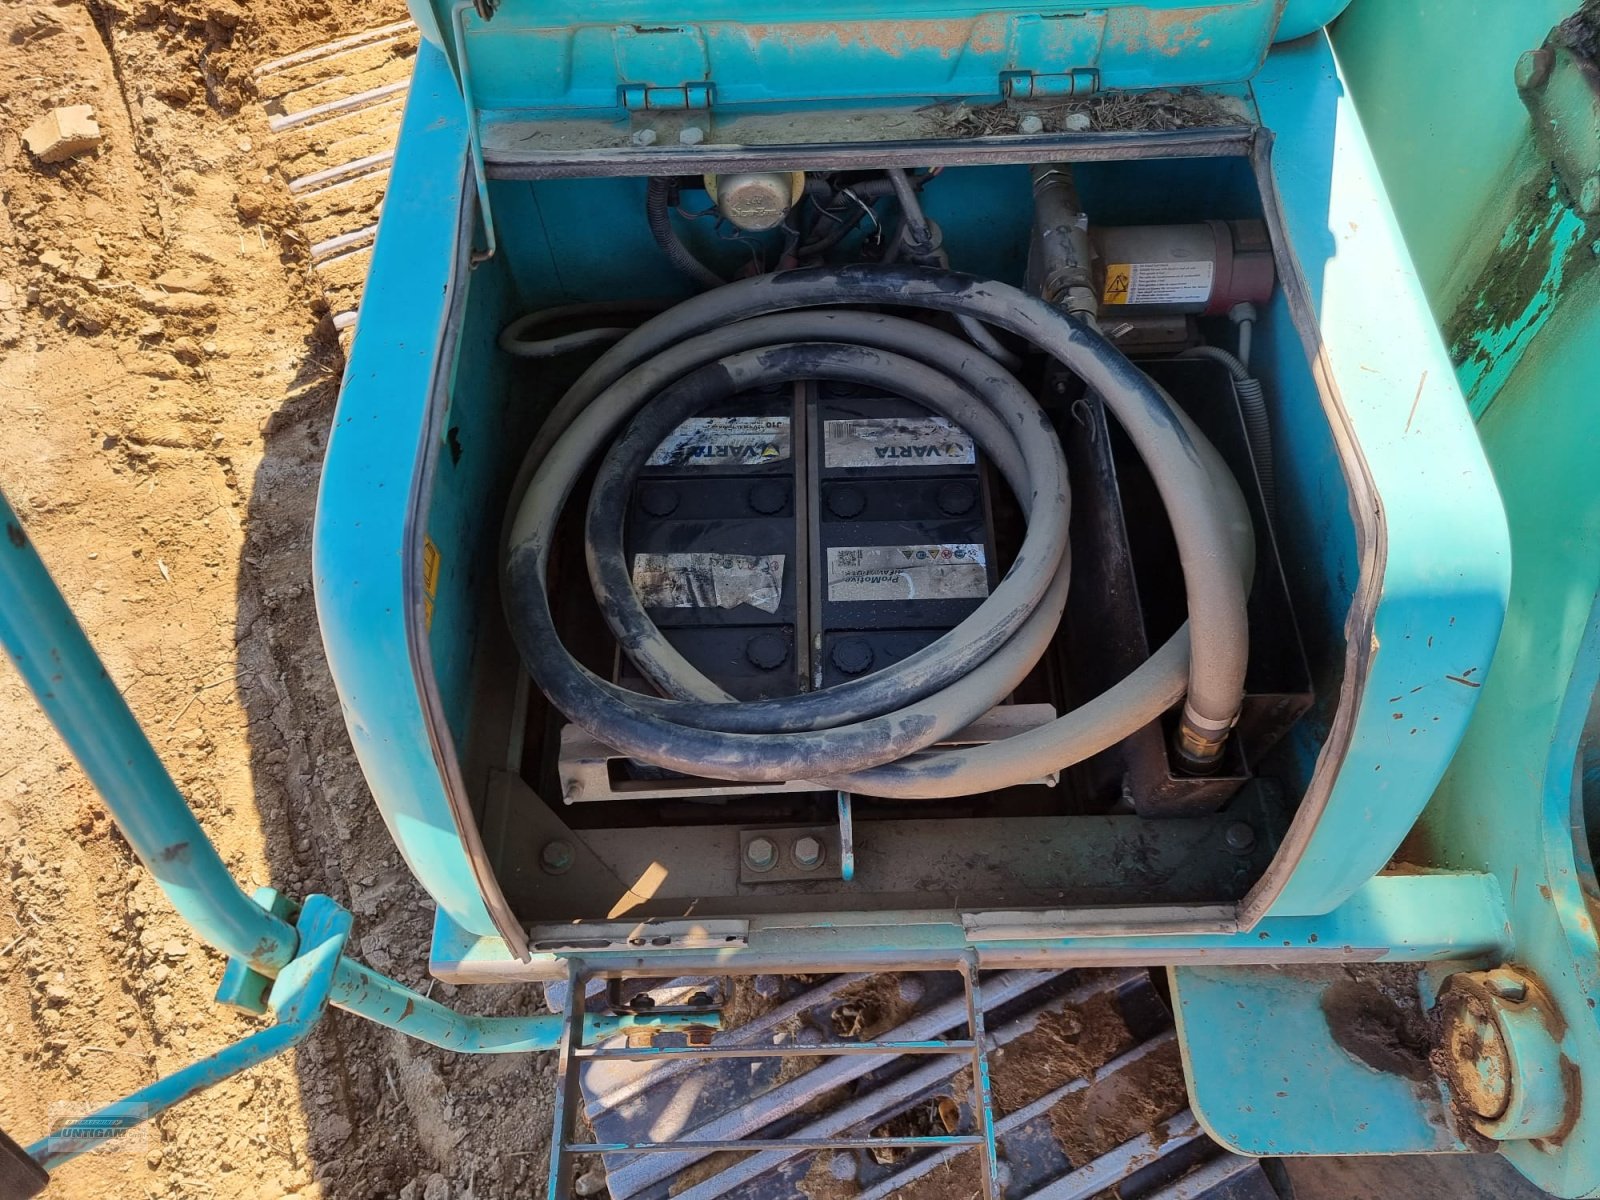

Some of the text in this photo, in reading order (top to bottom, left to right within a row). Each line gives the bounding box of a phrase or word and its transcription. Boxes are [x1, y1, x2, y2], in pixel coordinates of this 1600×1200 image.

[766, 421, 782, 429] J10
[691, 445, 759, 458] VARTA
[874, 446, 942, 459] VARTA
[844, 576, 899, 584] ProMotive
